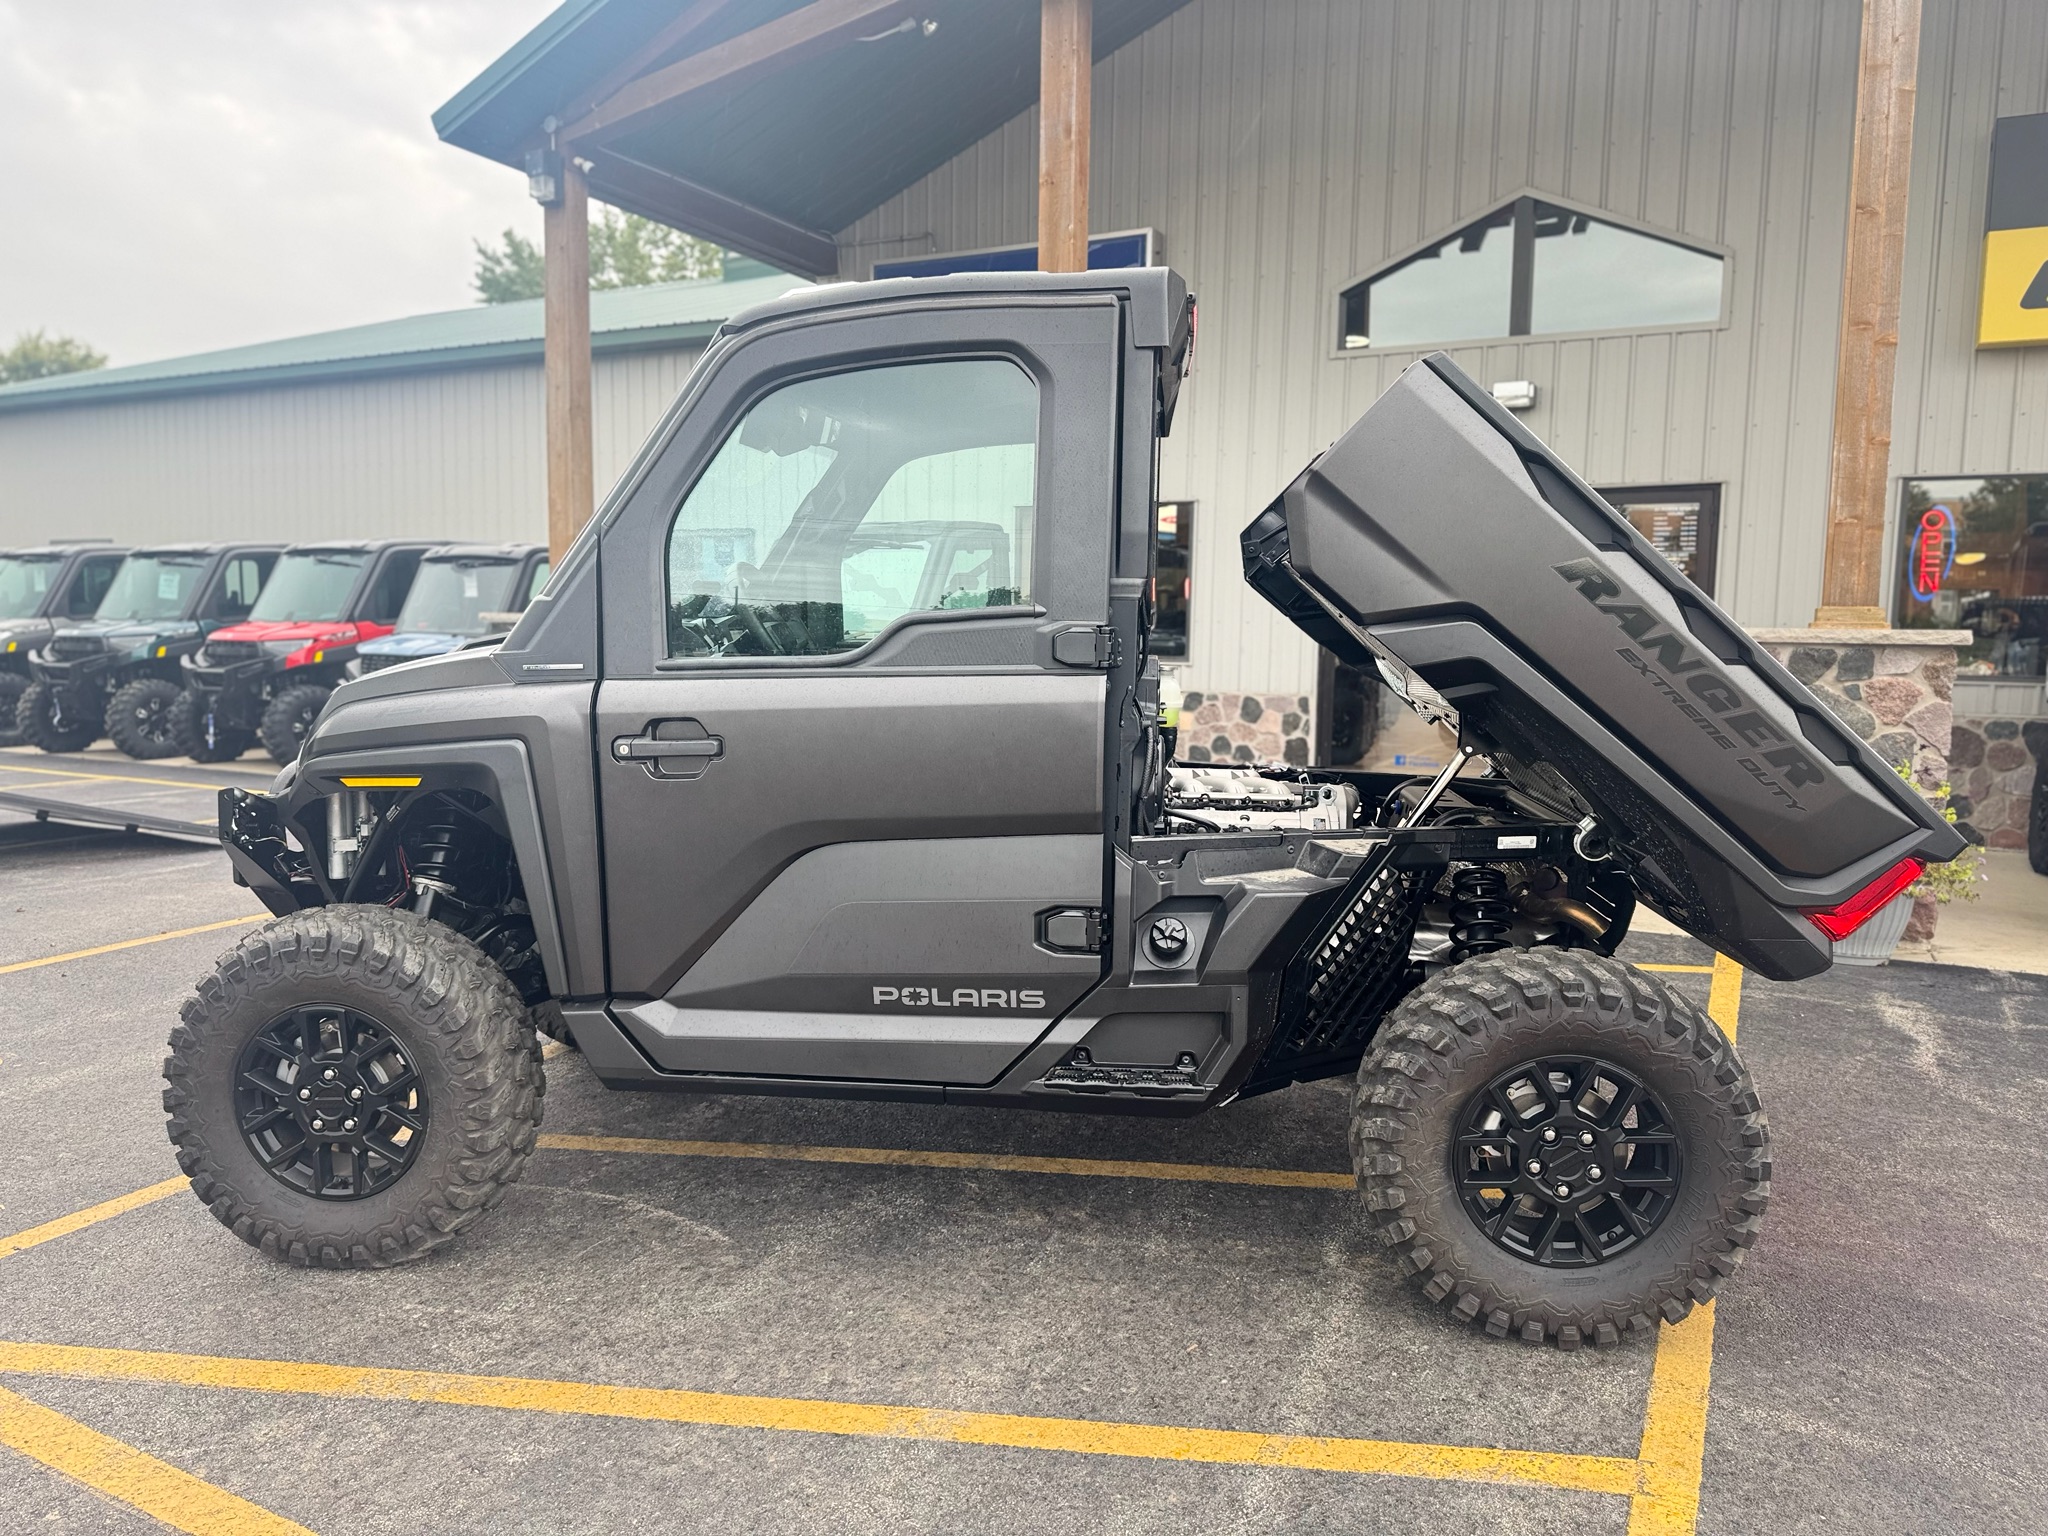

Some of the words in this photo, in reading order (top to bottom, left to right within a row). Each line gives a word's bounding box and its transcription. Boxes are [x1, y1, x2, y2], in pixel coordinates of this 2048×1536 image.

[1919, 509, 1946, 592] OPEN
[1549, 557, 1825, 789] RANGER
[1615, 647, 1738, 751] EXTREME
[1735, 757, 1808, 812] DUTY
[873, 986, 1046, 1009] POLARIS
[1669, 1092, 1712, 1177] CROSS
[1654, 1184, 1709, 1257] TRAIL
